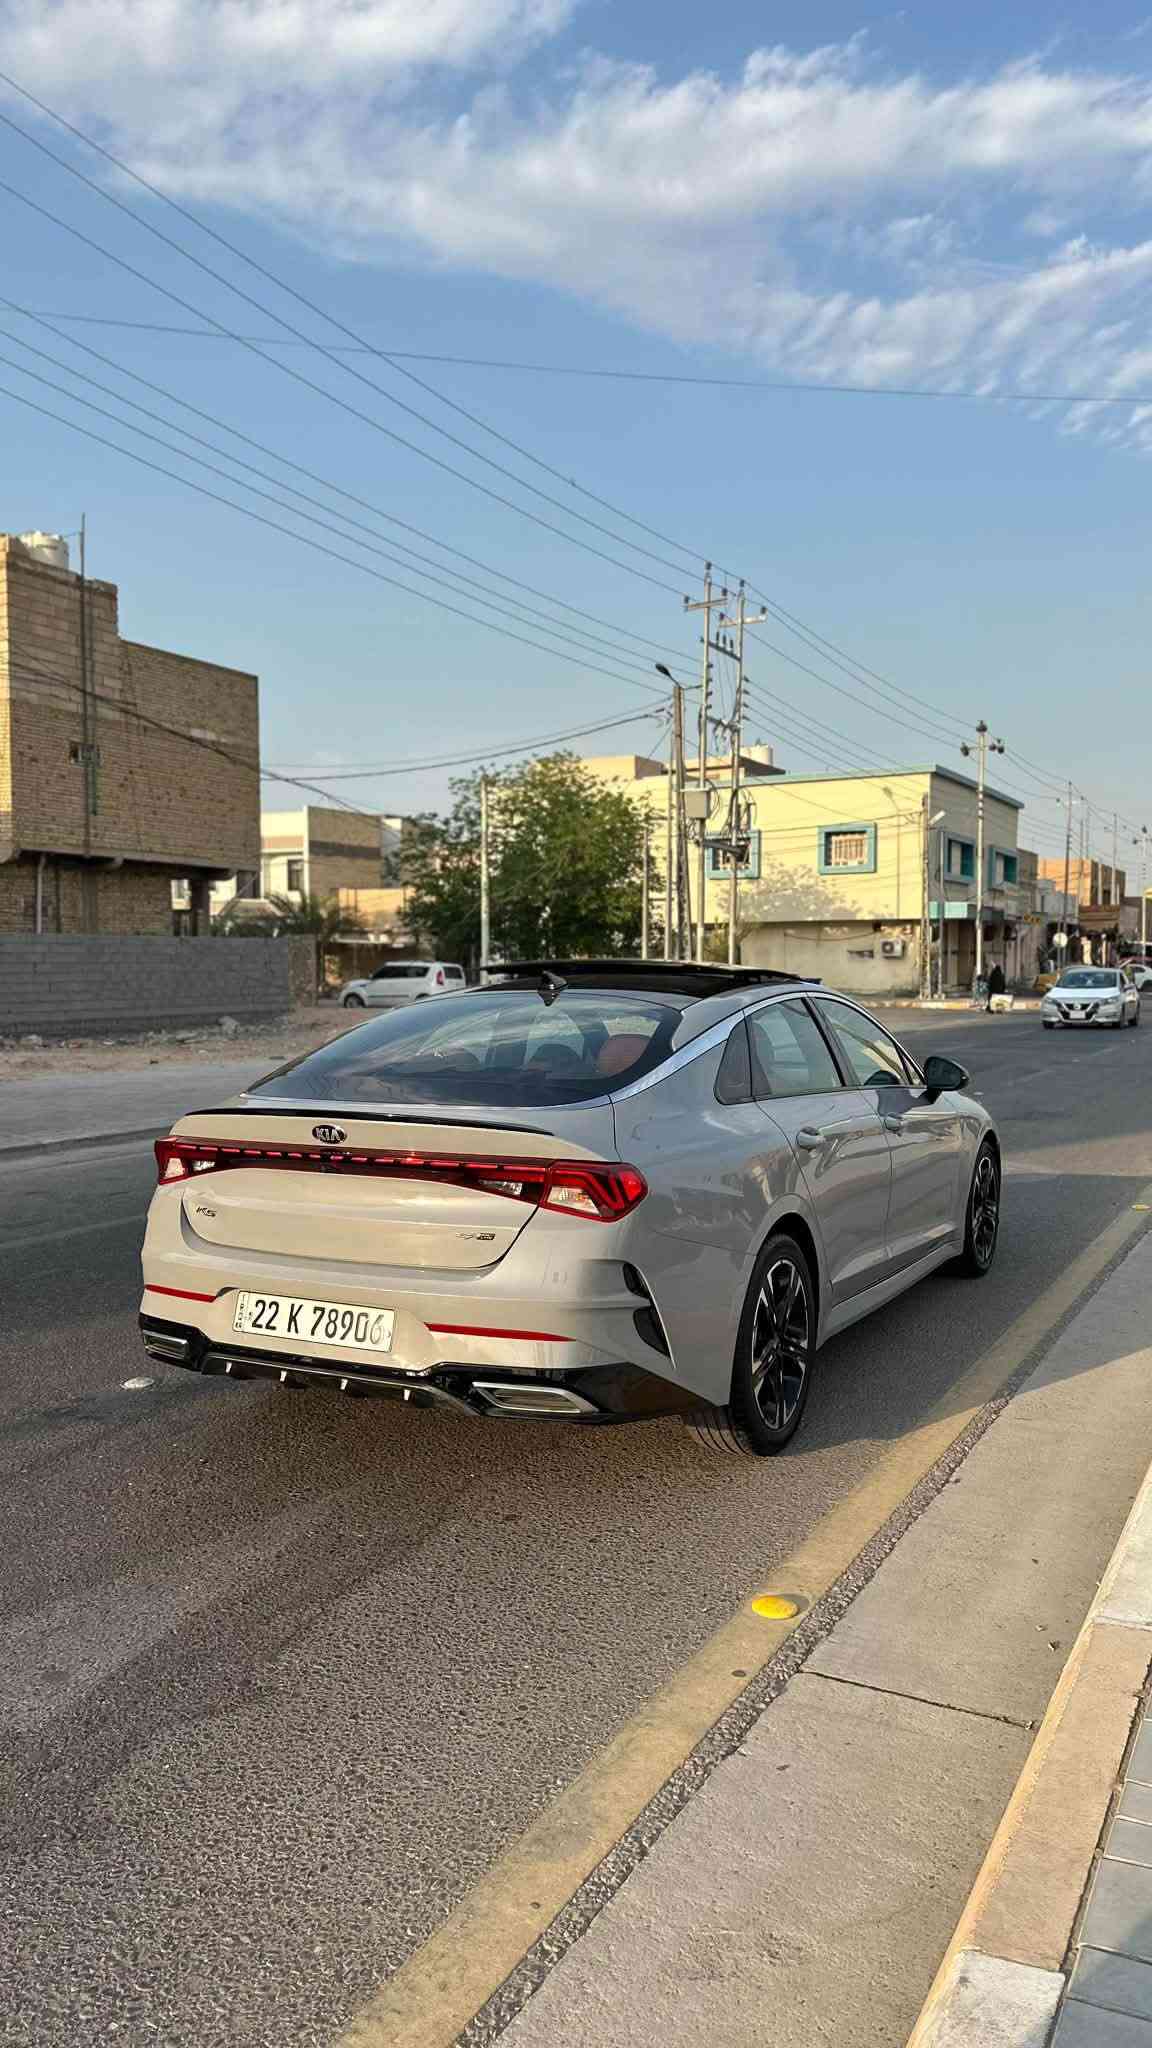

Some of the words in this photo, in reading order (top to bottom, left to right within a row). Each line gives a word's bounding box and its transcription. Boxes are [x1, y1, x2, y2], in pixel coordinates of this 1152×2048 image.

[315, 1127, 340, 1140] KIA
[251, 1299, 280, 1330] 22
[286, 1303, 304, 1334] K
[310, 1306, 385, 1345] 78906
